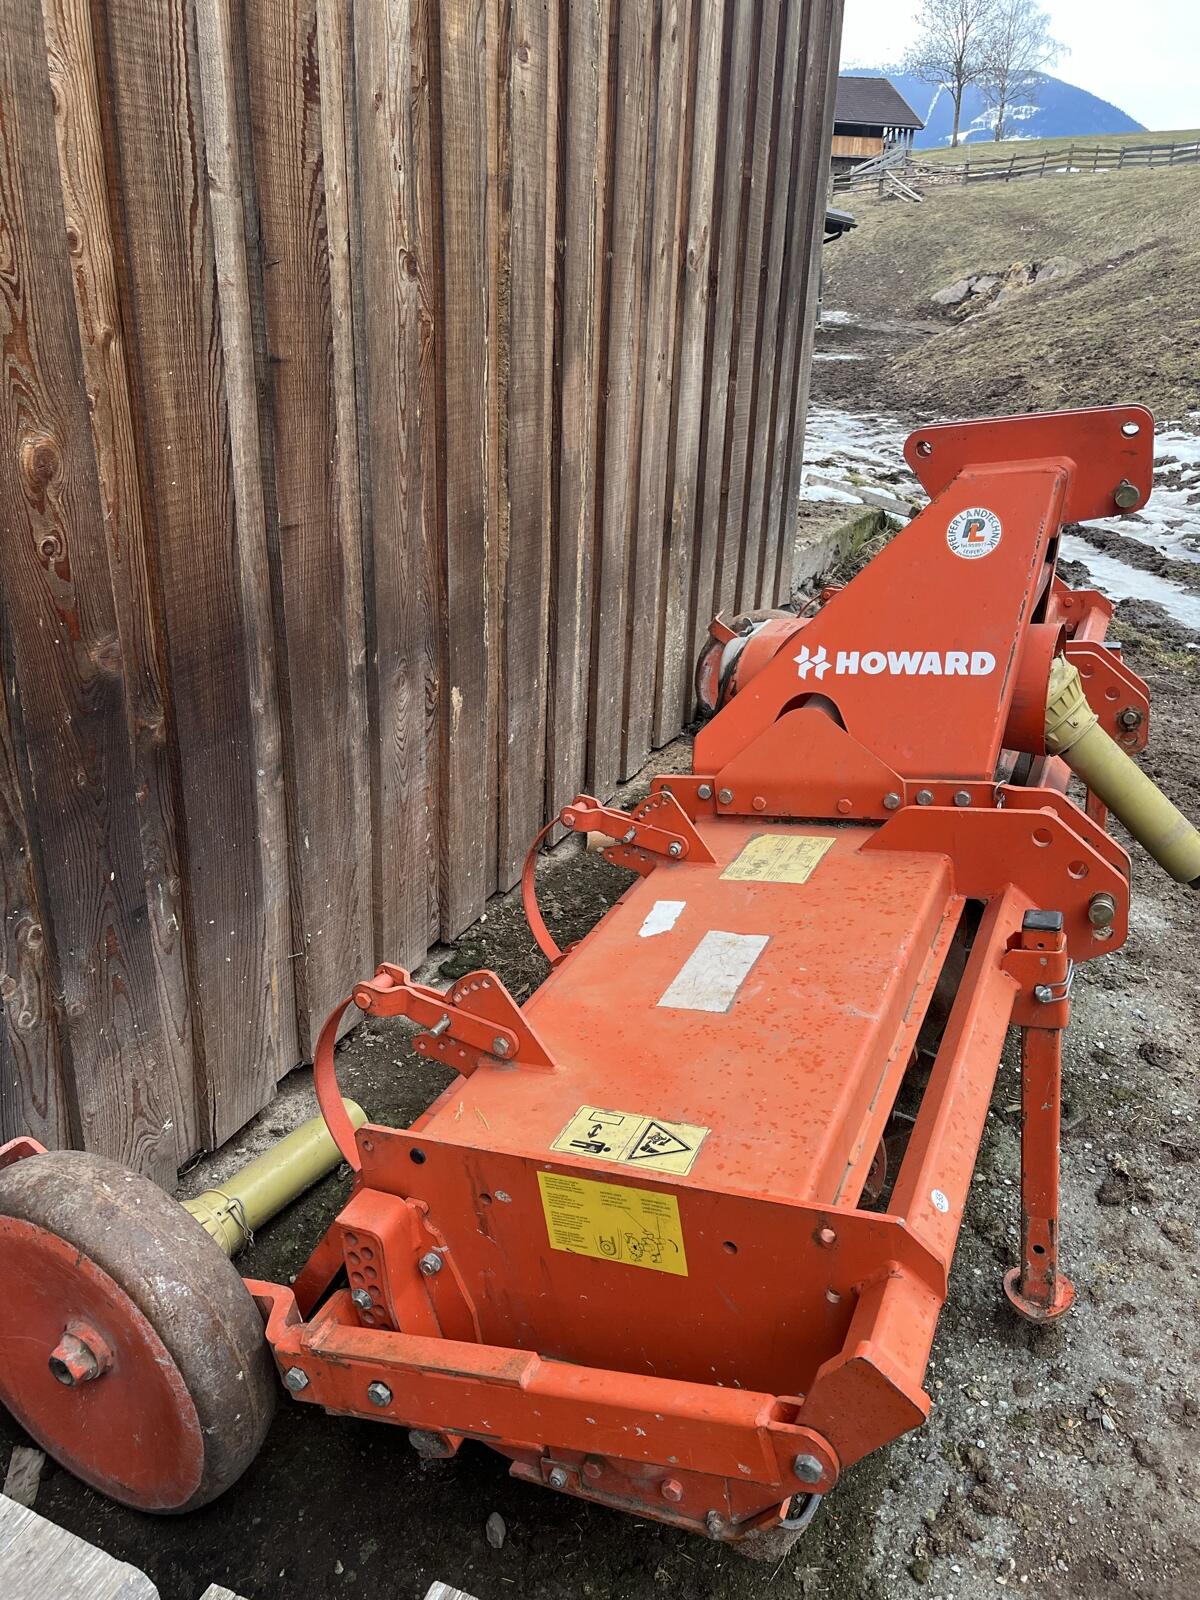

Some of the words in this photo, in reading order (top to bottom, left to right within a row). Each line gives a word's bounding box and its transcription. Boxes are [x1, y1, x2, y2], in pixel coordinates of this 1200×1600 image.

[948, 519, 961, 551] PFEIFER
[960, 508, 1000, 548] LANDTECHNIK
[835, 651, 996, 676] HOWARD
